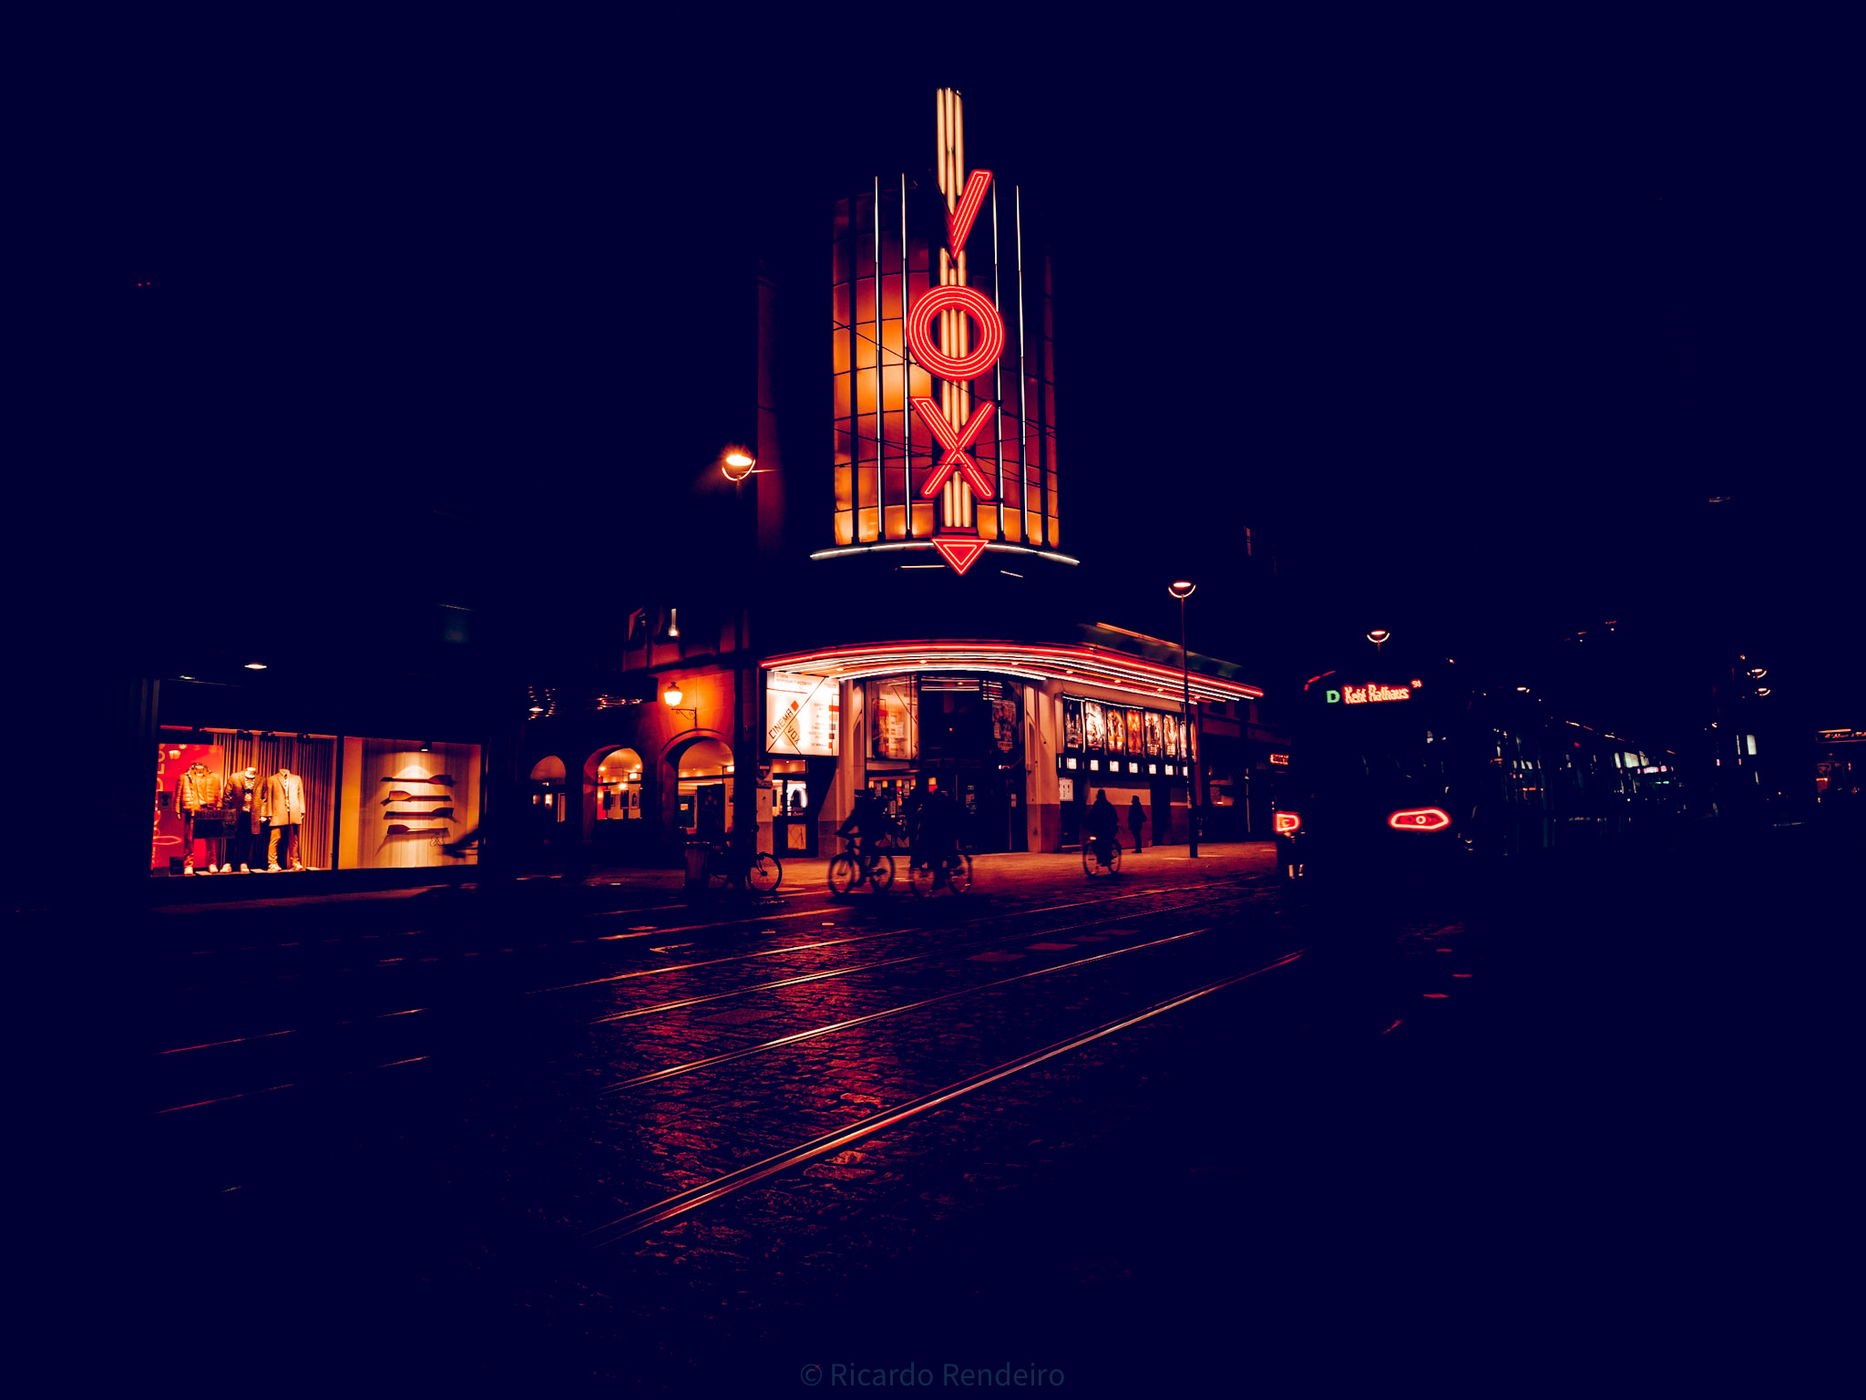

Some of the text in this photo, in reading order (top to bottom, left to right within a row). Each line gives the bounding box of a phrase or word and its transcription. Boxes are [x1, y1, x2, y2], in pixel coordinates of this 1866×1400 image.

[1326, 690, 1340, 703] D
[1367, 684, 1410, 702] Rathaus
[768, 707, 794, 740] CINEMA
[787, 726, 800, 745] VOX
